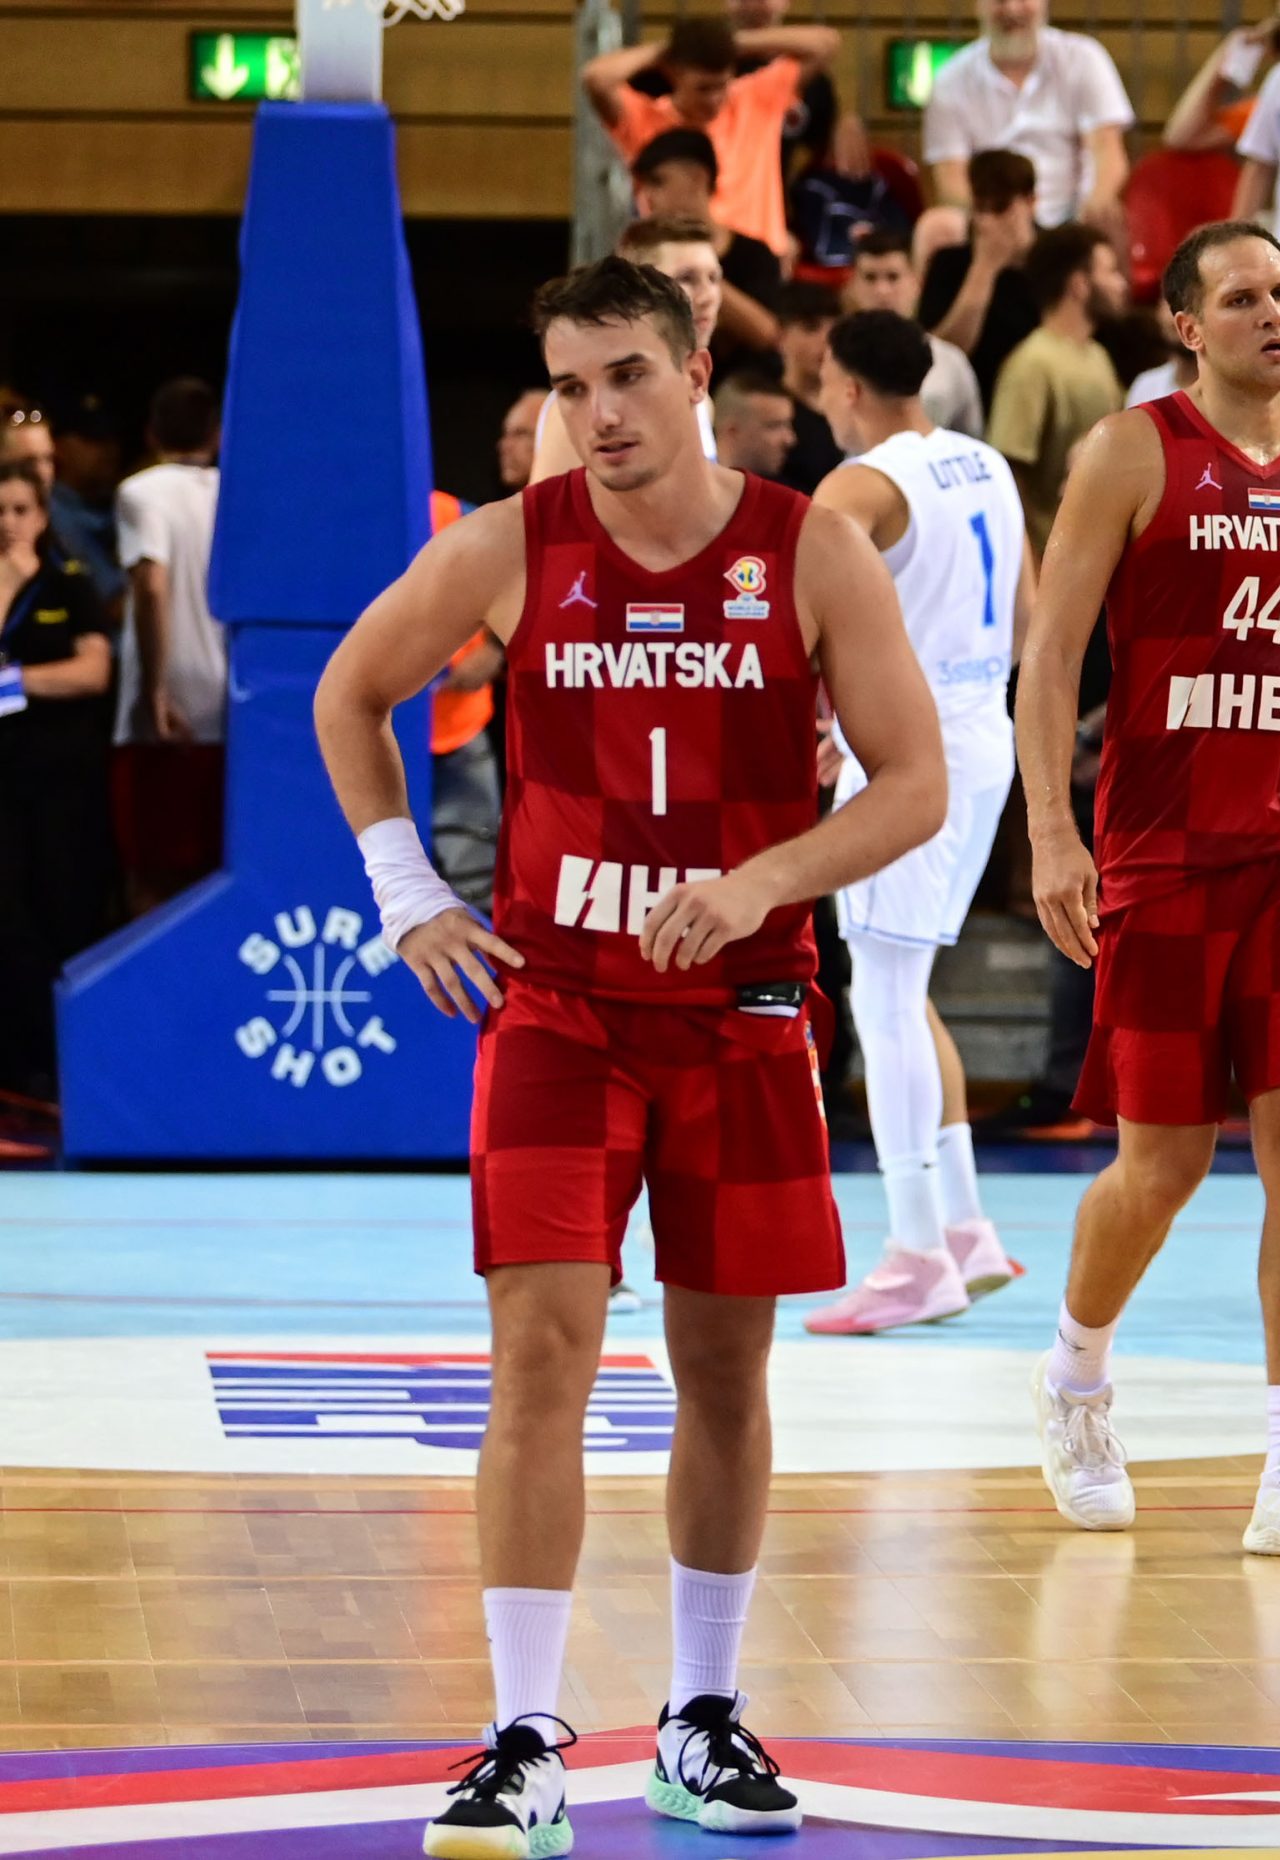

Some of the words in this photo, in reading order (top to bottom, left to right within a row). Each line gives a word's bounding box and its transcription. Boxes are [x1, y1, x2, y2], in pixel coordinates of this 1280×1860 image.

[968, 510, 996, 627] 1
[545, 642, 765, 689] HRVATSKA
[648, 726, 667, 816] 1
[238, 904, 400, 977] SURE
[235, 1015, 397, 1088] SHOT
